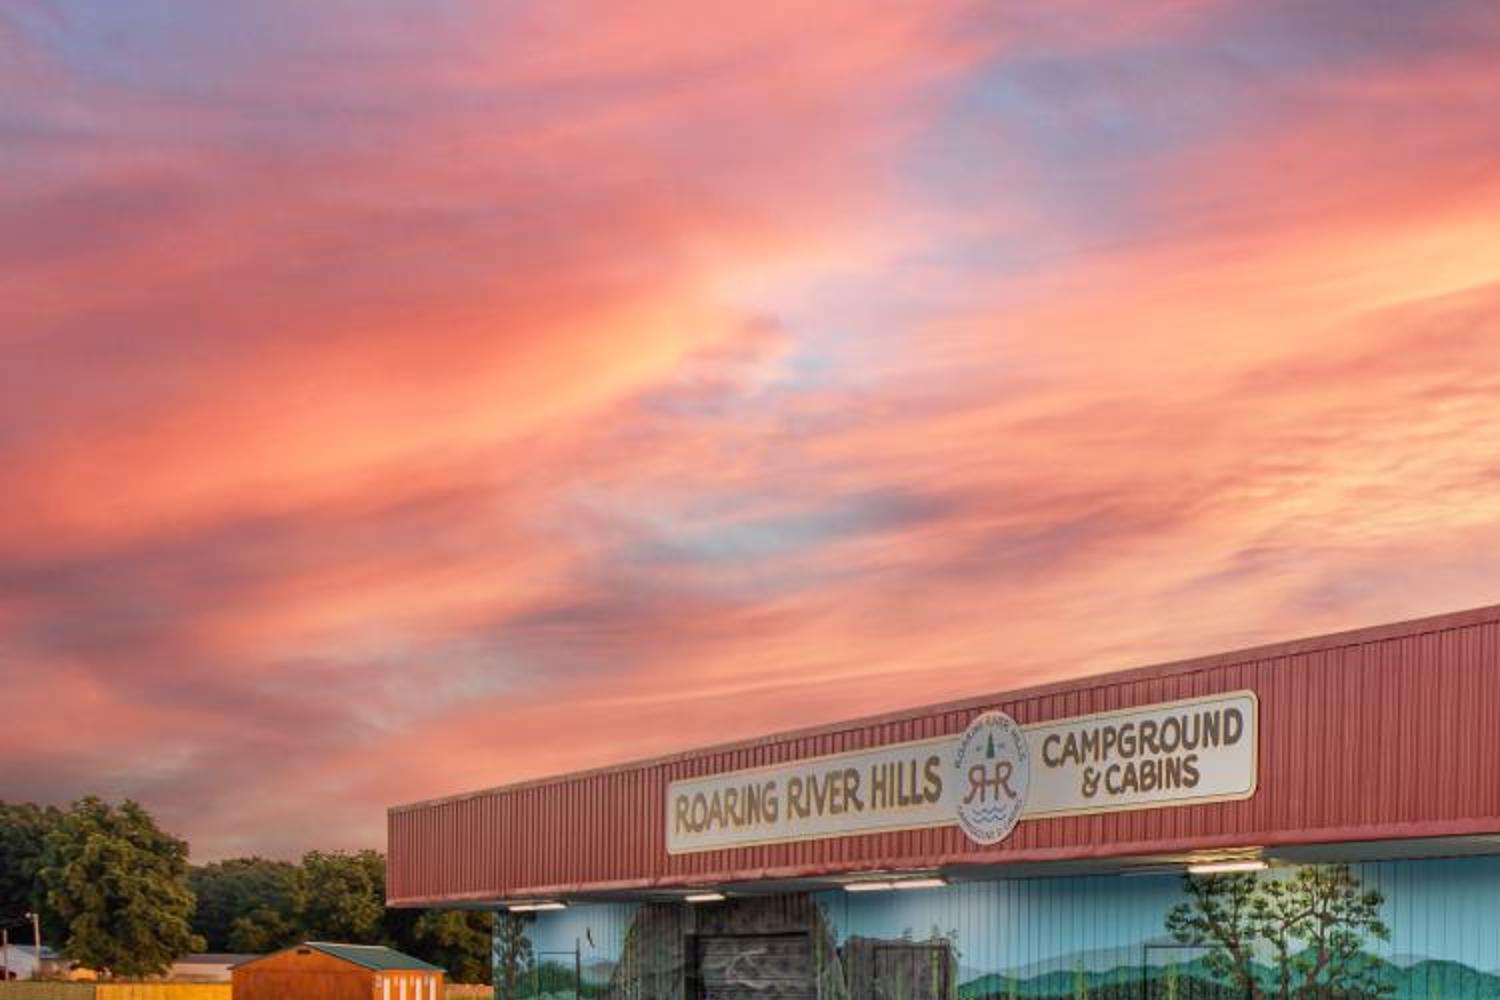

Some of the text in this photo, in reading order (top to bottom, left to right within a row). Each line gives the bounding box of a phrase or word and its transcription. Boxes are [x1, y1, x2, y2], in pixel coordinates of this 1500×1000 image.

[1042, 707, 1244, 769] CAMPGROUND
[674, 755, 943, 834] ROARING RIVER HILLS
[1081, 753, 1200, 798] & CABINS
